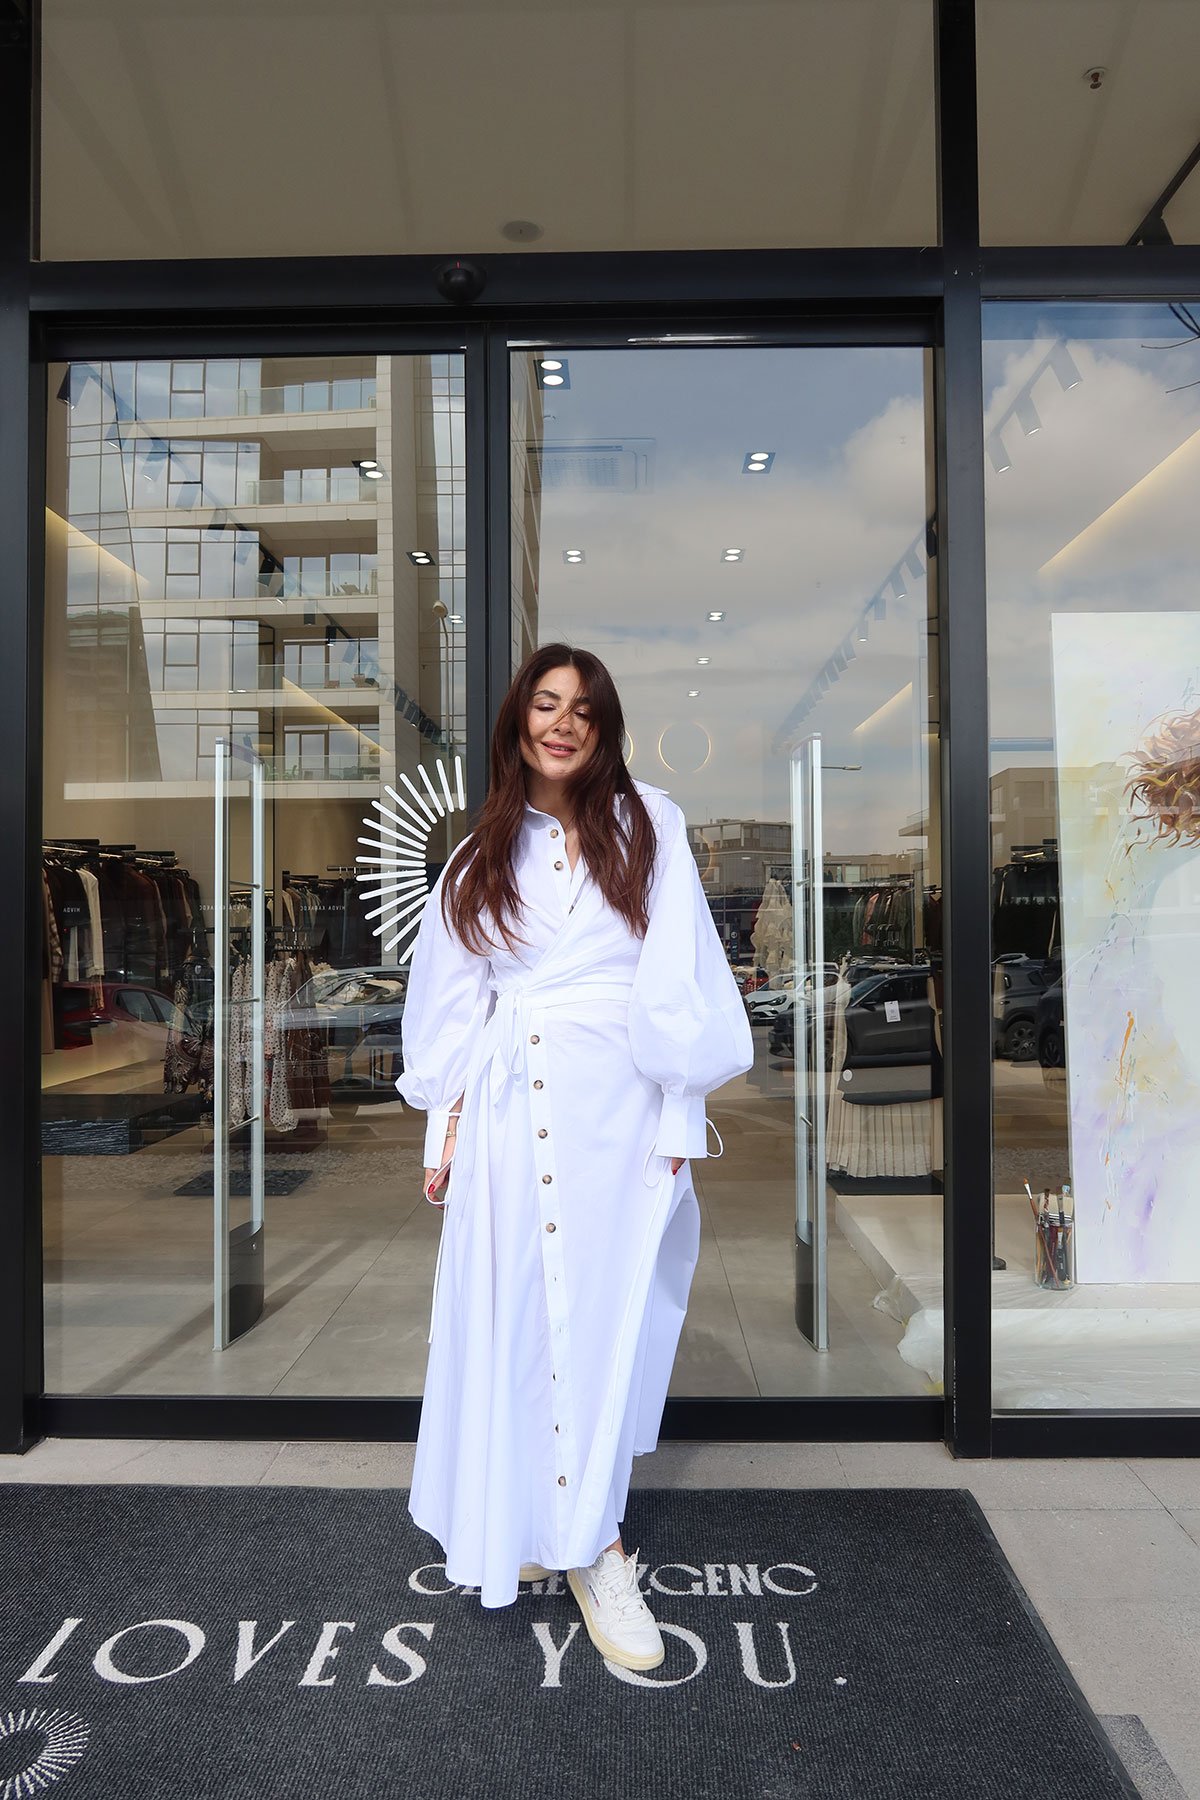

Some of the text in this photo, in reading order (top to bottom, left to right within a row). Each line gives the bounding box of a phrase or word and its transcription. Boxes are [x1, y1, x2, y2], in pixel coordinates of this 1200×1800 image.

[408, 1563, 559, 1596] OE
[637, 1563, 818, 1596] GENC
[17, 1618, 435, 1687] LOVES
